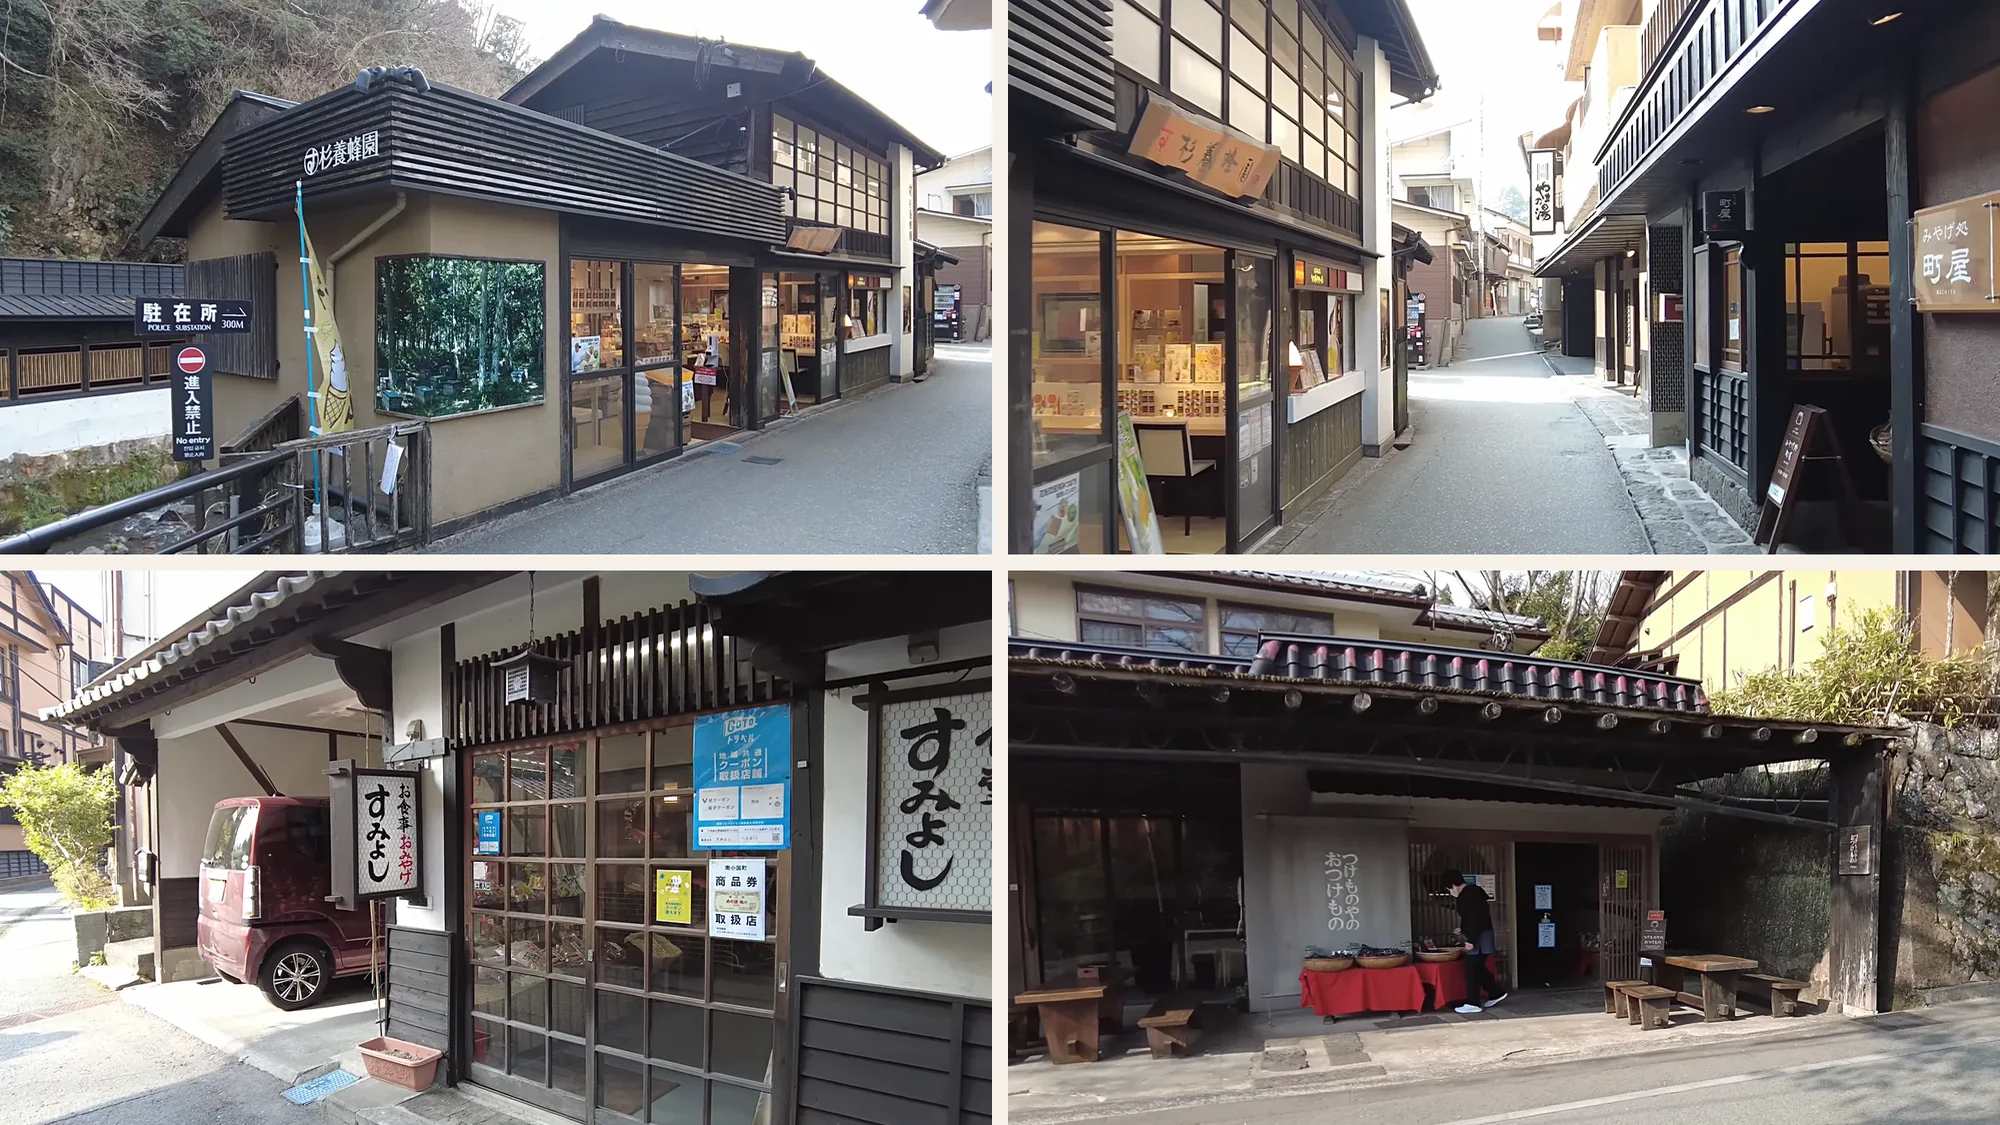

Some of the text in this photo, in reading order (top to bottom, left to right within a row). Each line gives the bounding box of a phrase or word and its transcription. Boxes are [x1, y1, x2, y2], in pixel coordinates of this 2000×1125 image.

[319, 130, 380, 170] 杉養蜂園
[1718, 198, 1731, 219] 町屋
[1922, 220, 1969, 243] みやげ処
[1923, 247, 1972, 285] 町屋
[142, 302, 218, 323] 駐在所
[147, 323, 212, 332] POLICE SUBSTATION
[221, 319, 244, 329] 300M
[184, 375, 202, 435] 進入禁止
[176, 436, 211, 445] No entry
[727, 734, 755, 745] トラベル
[719, 758, 762, 770] クーポン
[900, 707, 966, 891] すみよし
[364, 783, 391, 883] すみよし
[715, 876, 757, 887] 商品券
[1324, 851, 1344, 931] おつけもの
[1342, 853, 1360, 931] つけものやの
[715, 913, 757, 926] 取扱店
